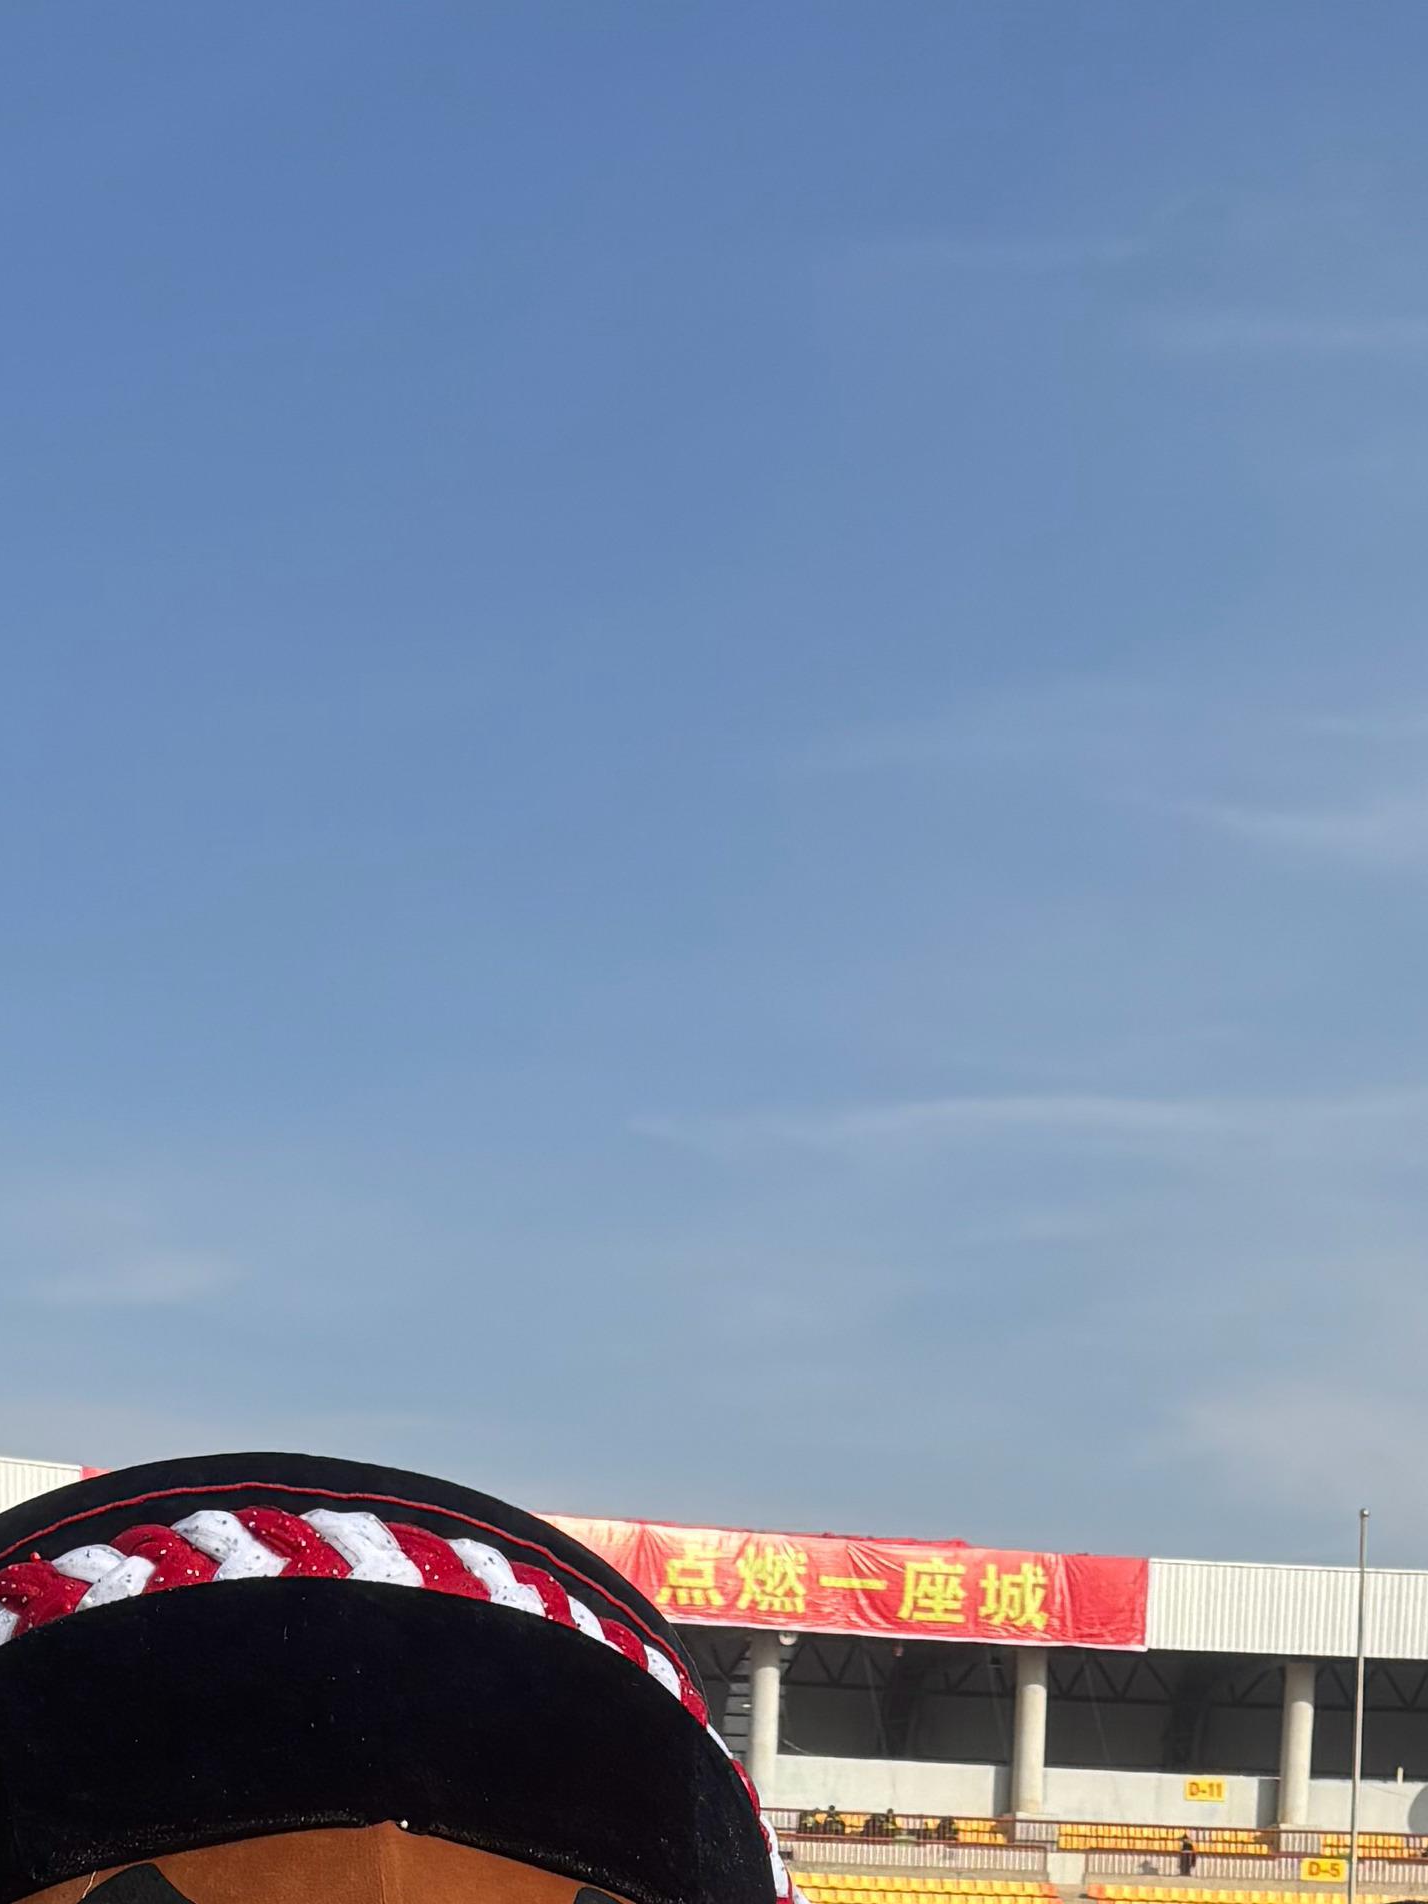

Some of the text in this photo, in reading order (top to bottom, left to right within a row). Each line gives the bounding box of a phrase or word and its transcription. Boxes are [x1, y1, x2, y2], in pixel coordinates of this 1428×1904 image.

[652, 1543, 1048, 1630] 点燃一座城
[1188, 1781, 1223, 1799] D-11
[1307, 1861, 1341, 1878] D-5
